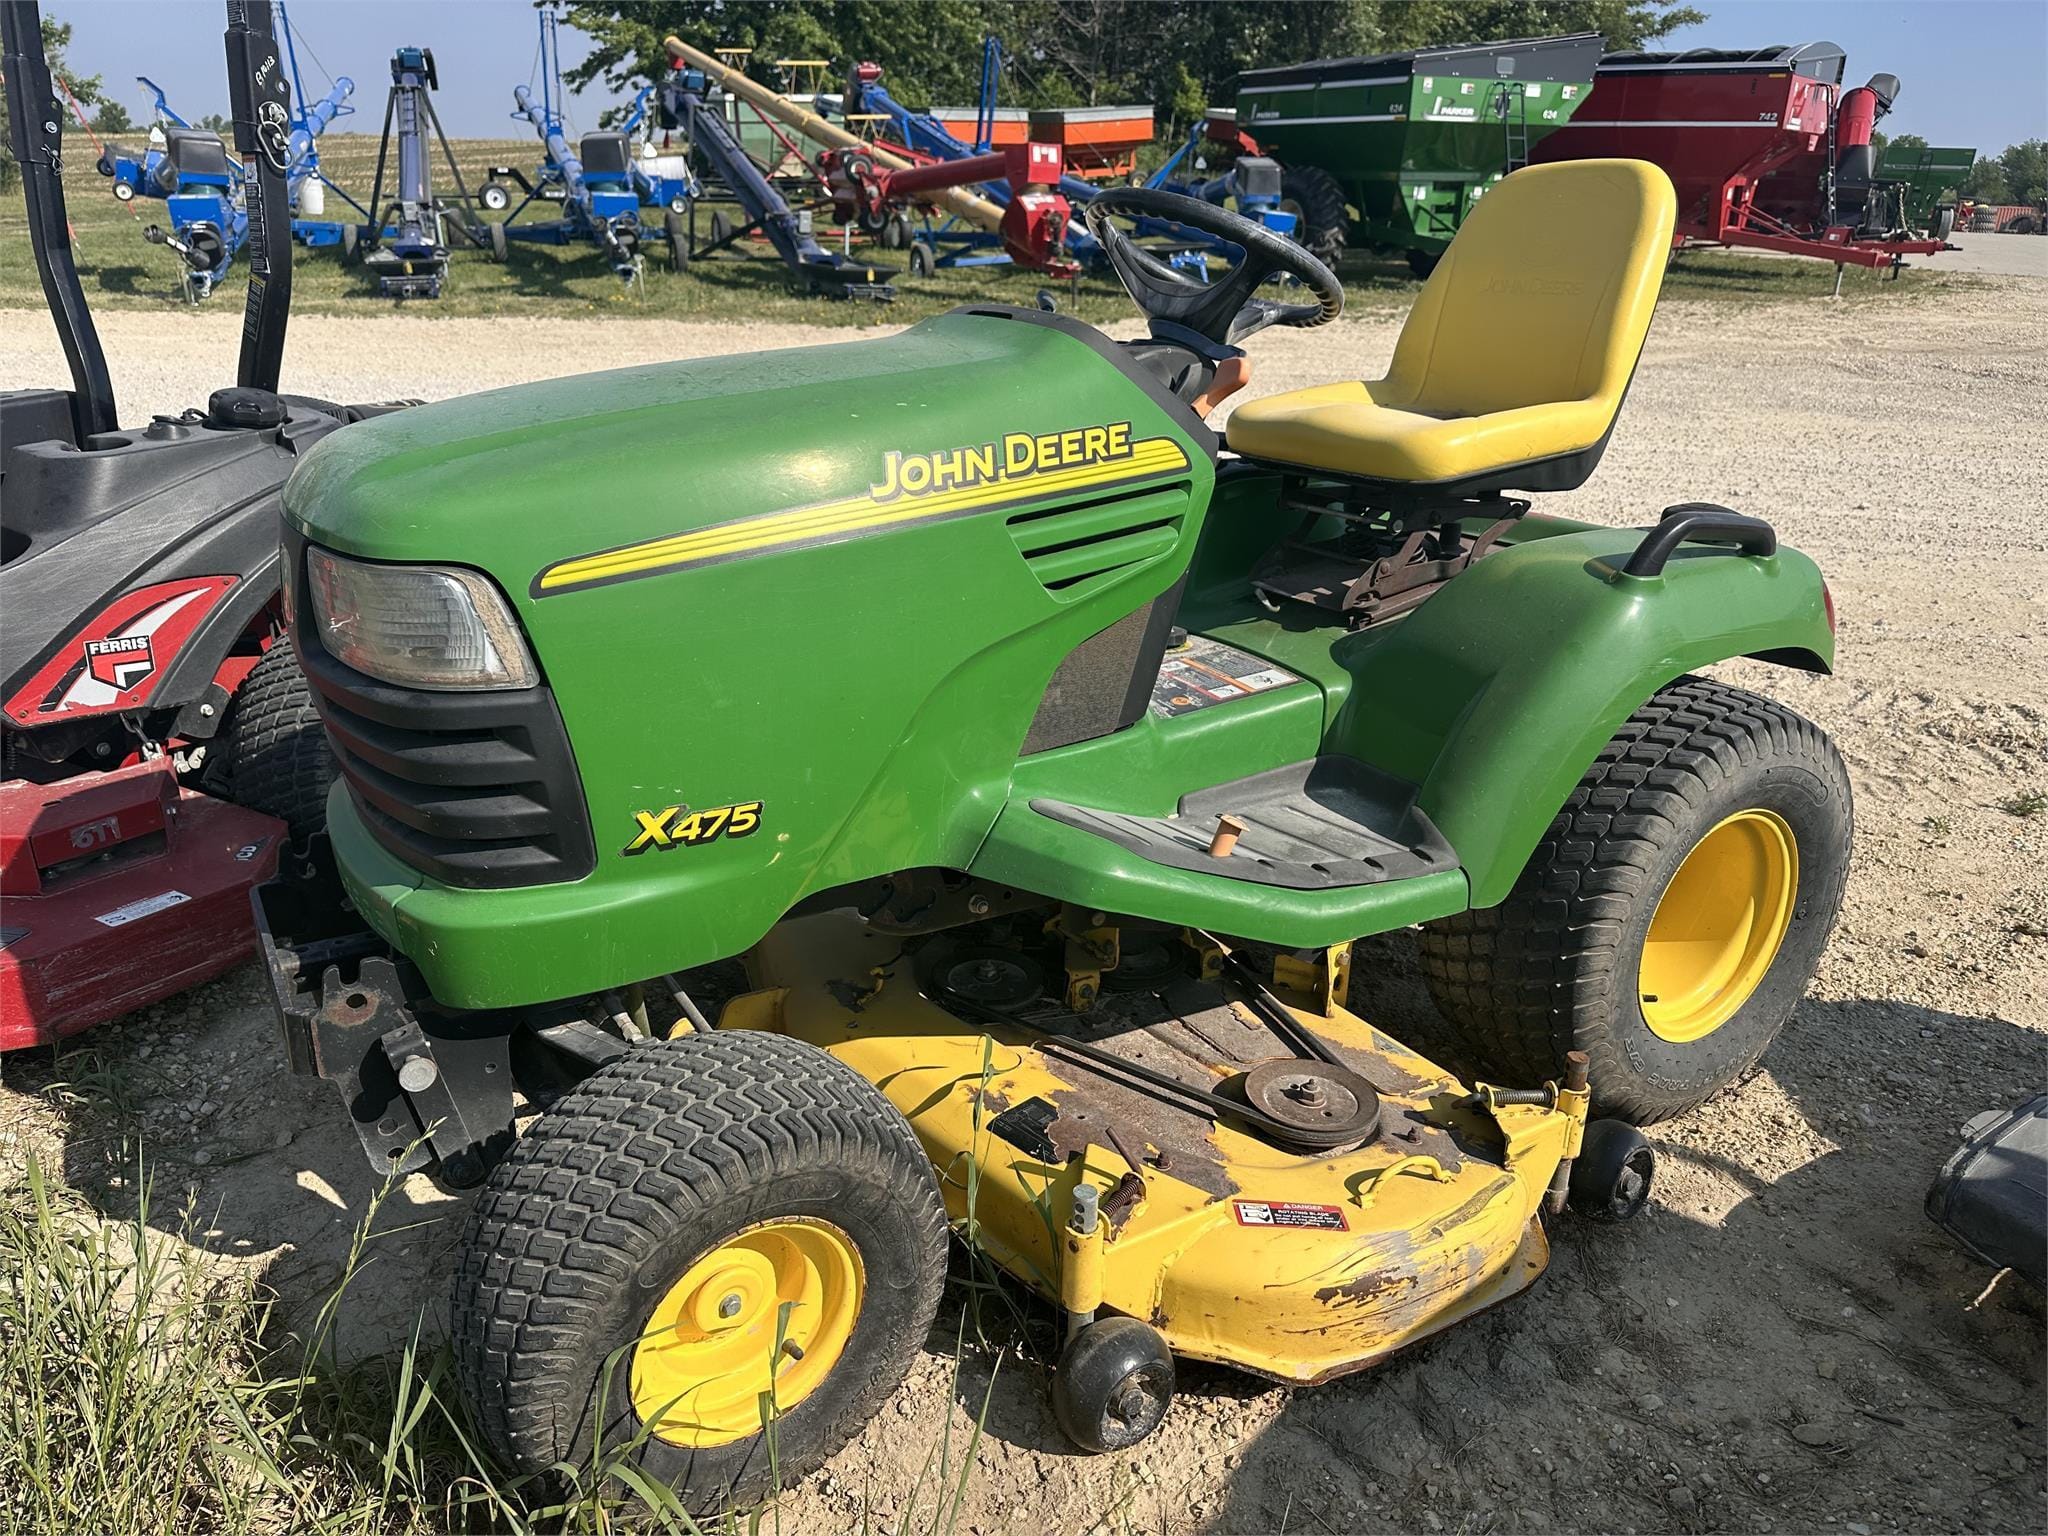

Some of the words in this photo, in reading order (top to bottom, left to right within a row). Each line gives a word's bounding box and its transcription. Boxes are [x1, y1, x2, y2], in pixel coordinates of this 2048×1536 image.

[1440, 106, 1475, 116] PARKER
[1542, 109, 1558, 120] 624
[1758, 112, 1778, 121] 742
[870, 444, 996, 500] JOHN
[1003, 421, 1132, 478] DEERE
[89, 637, 148, 655] FERRIS
[620, 801, 764, 855] X475
[1291, 1203, 1324, 1211] DANGER
